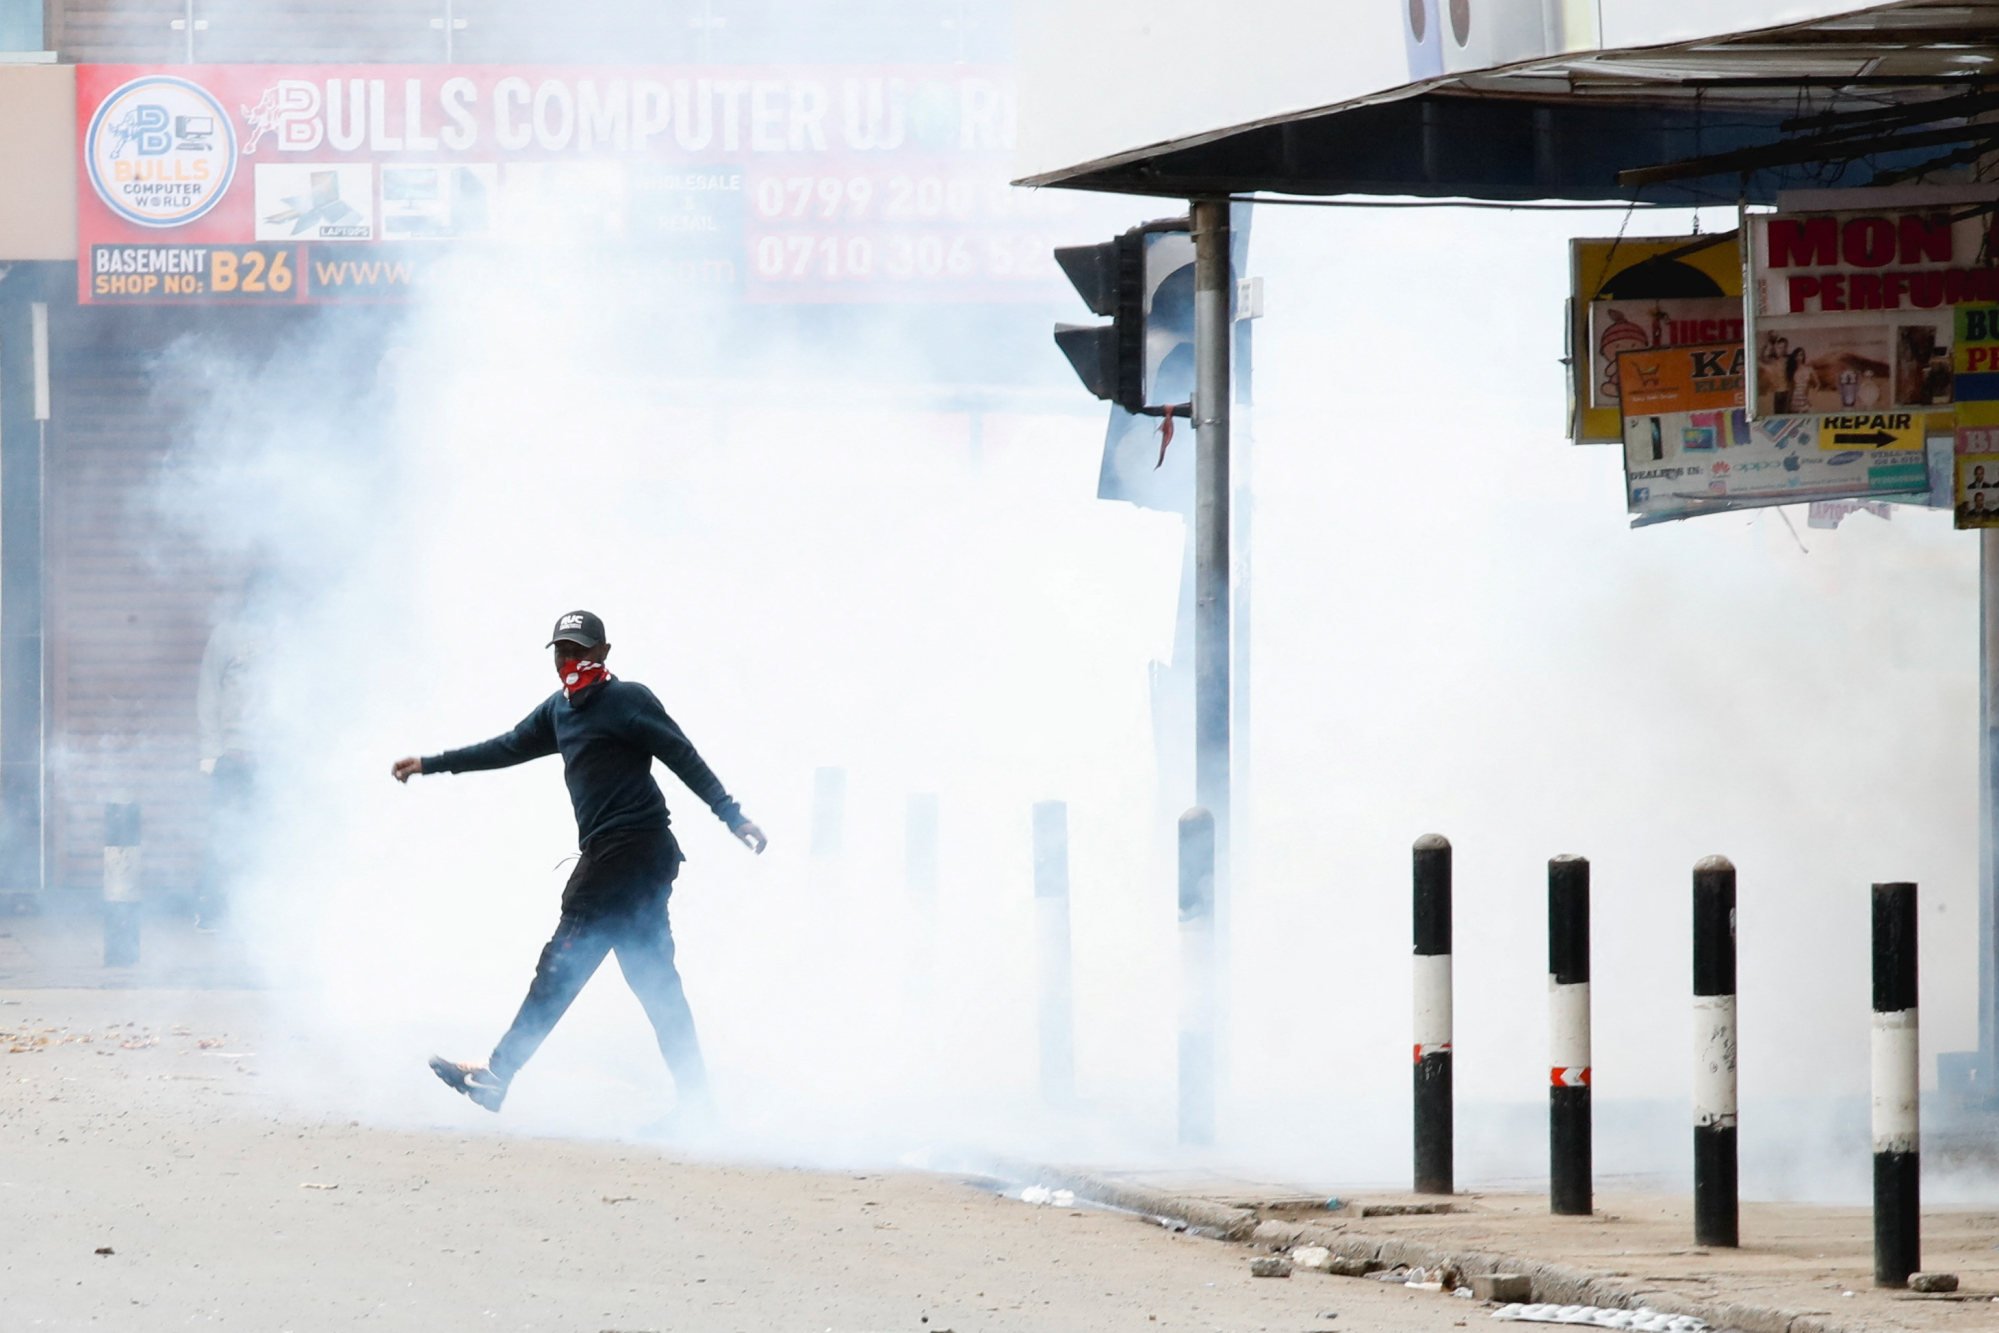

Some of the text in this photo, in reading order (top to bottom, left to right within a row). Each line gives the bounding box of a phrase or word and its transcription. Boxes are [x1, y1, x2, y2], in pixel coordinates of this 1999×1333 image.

[279, 77, 479, 153] BULLS
[494, 76, 827, 152] COMPUTER
[114, 159, 210, 182] BULLS
[123, 183, 202, 196] COMPUTER
[757, 177, 872, 217] 0799
[96, 249, 293, 292] BASEMENT B26
[757, 236, 871, 276] 0710
[95, 275, 203, 294] SHOP NO:
[1824, 414, 1912, 430] REPAIR
